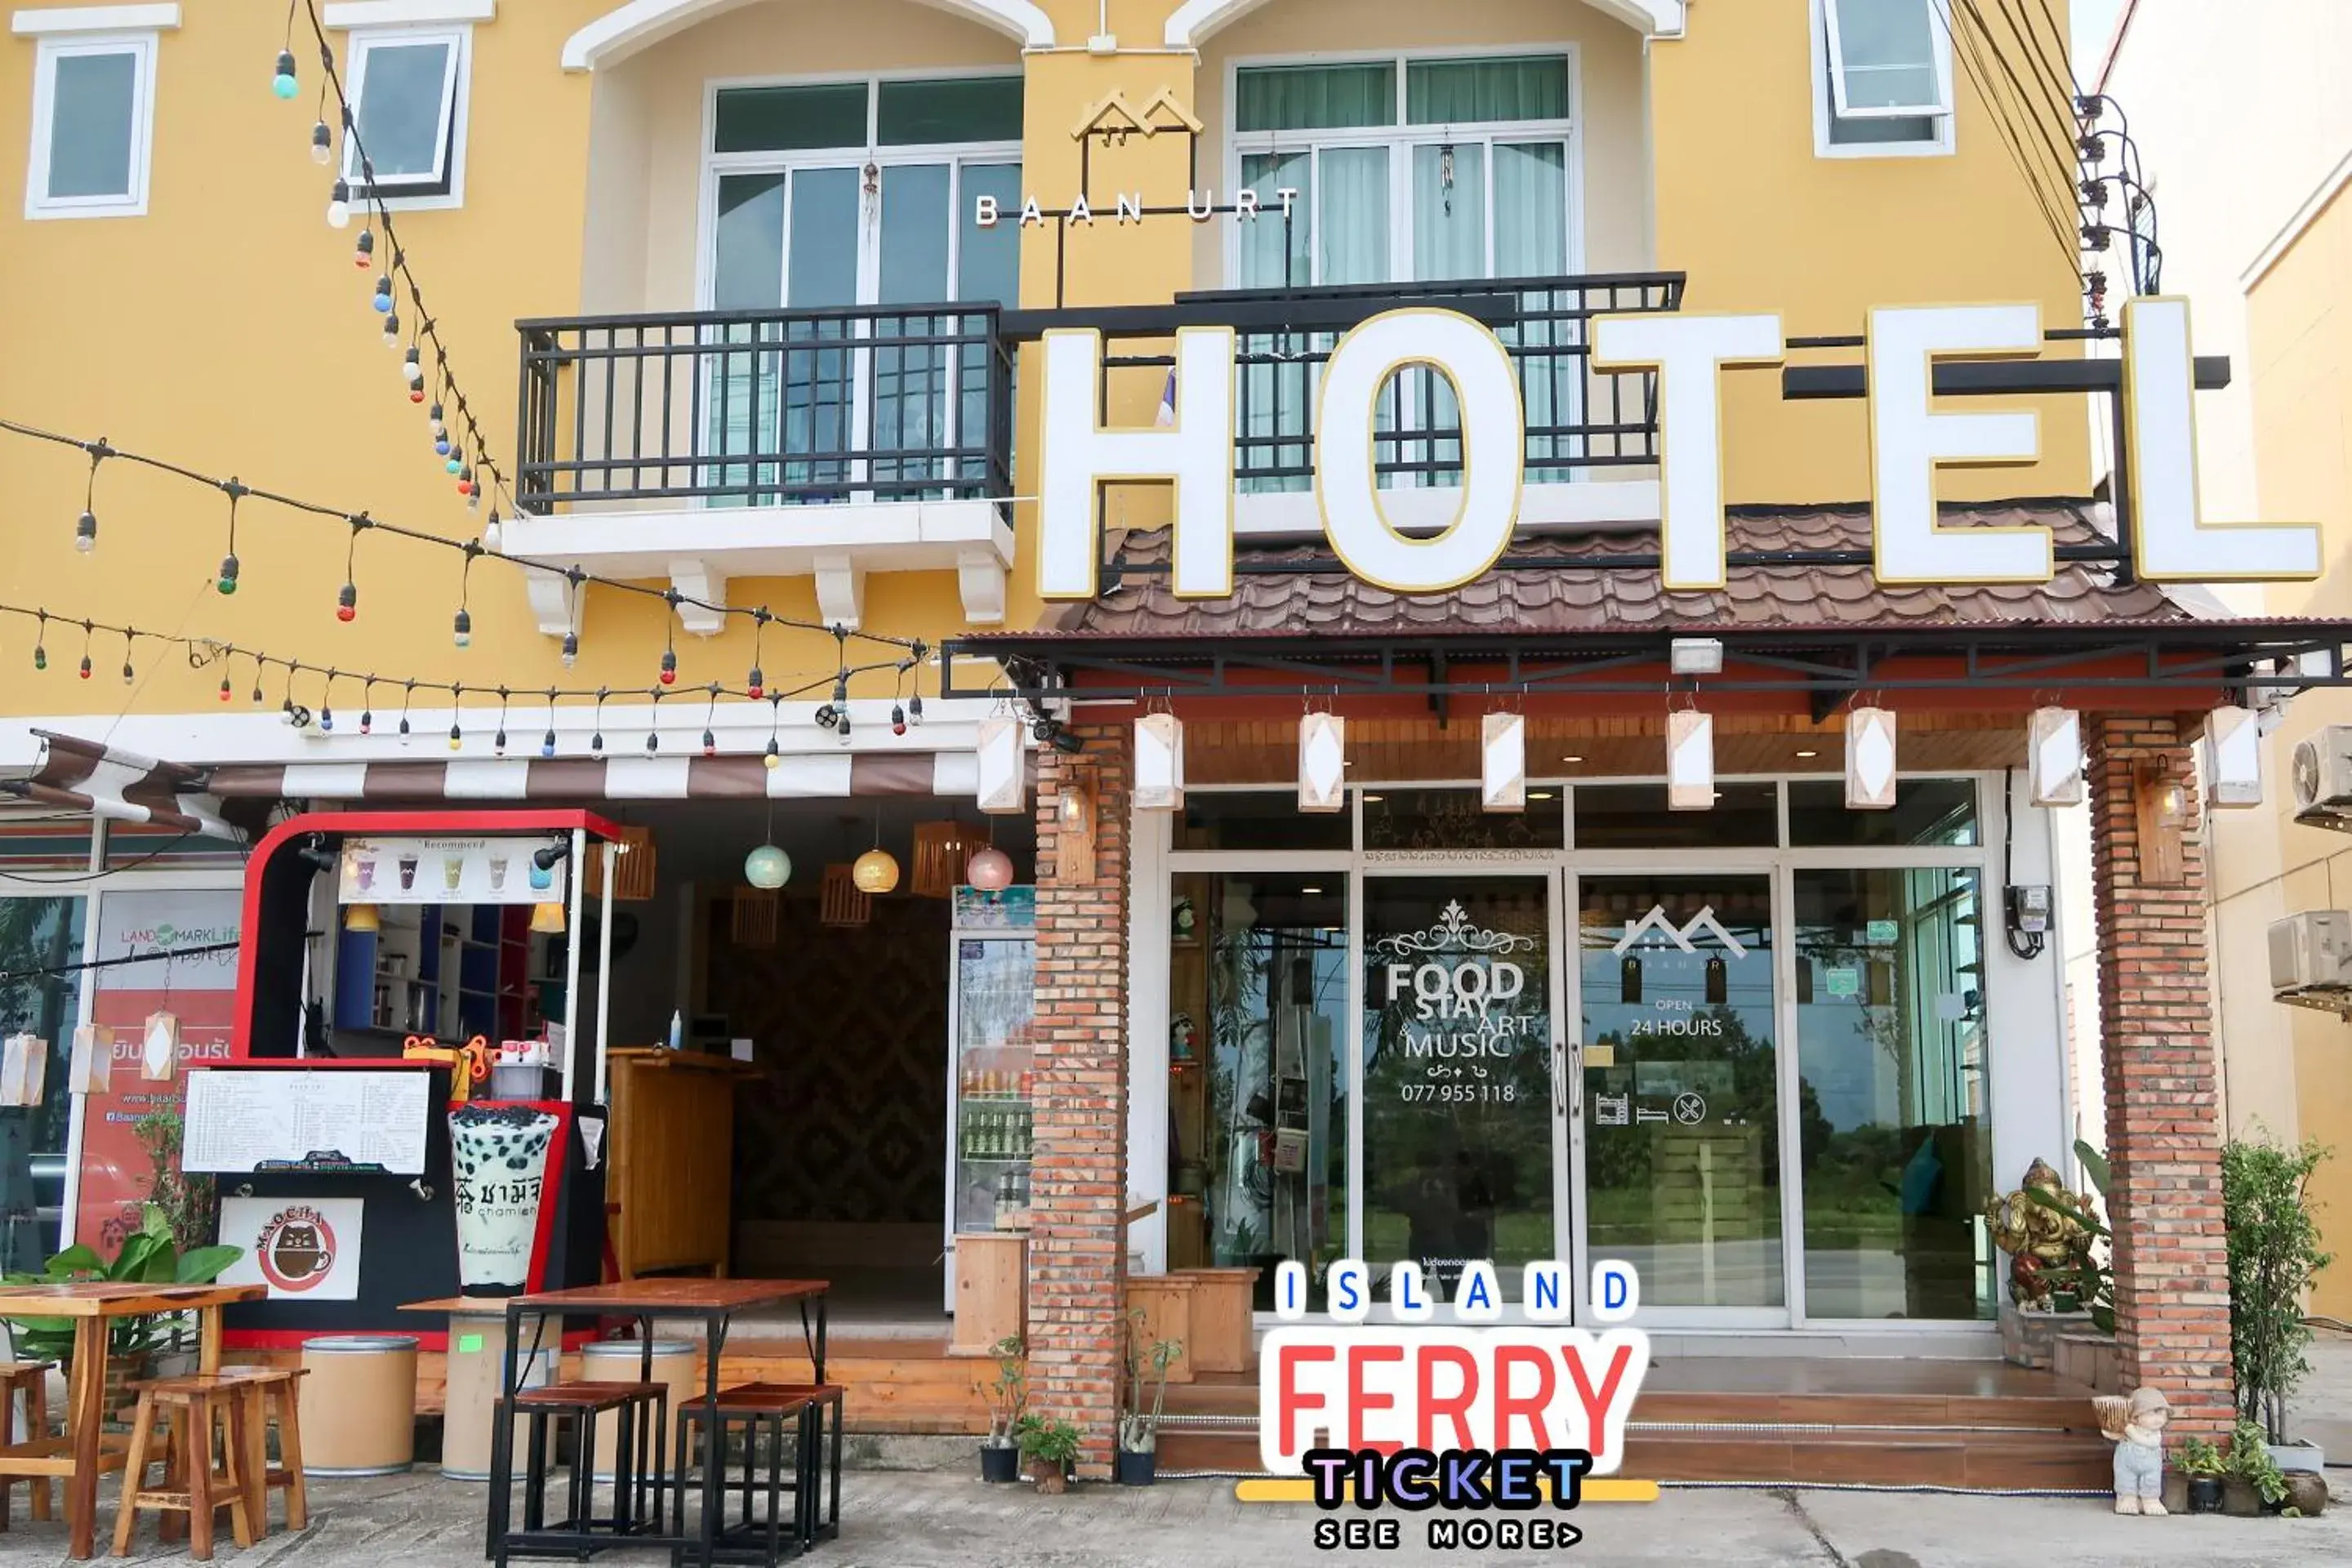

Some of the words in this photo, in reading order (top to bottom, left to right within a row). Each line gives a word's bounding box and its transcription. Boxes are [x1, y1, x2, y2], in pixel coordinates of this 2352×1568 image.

[976, 193, 1143, 227] BAAN
[1188, 188, 1298, 223] URT
[1036, 293, 2324, 600] HOTEL
[1388, 962, 1525, 1001] FOOD
[1415, 992, 1494, 1021] STAY
[1655, 999, 1693, 1011] OPEN
[1477, 1015, 1535, 1036] ART
[1631, 1019, 1652, 1036] 24
[1658, 1019, 1722, 1036] HOURS
[1404, 1032, 1511, 1058] MUSIC
[1401, 1084, 1436, 1102] 077
[1440, 1084, 1475, 1102] 955
[1480, 1084, 1515, 1102] 118
[256, 1205, 324, 1249] MAOCHA
